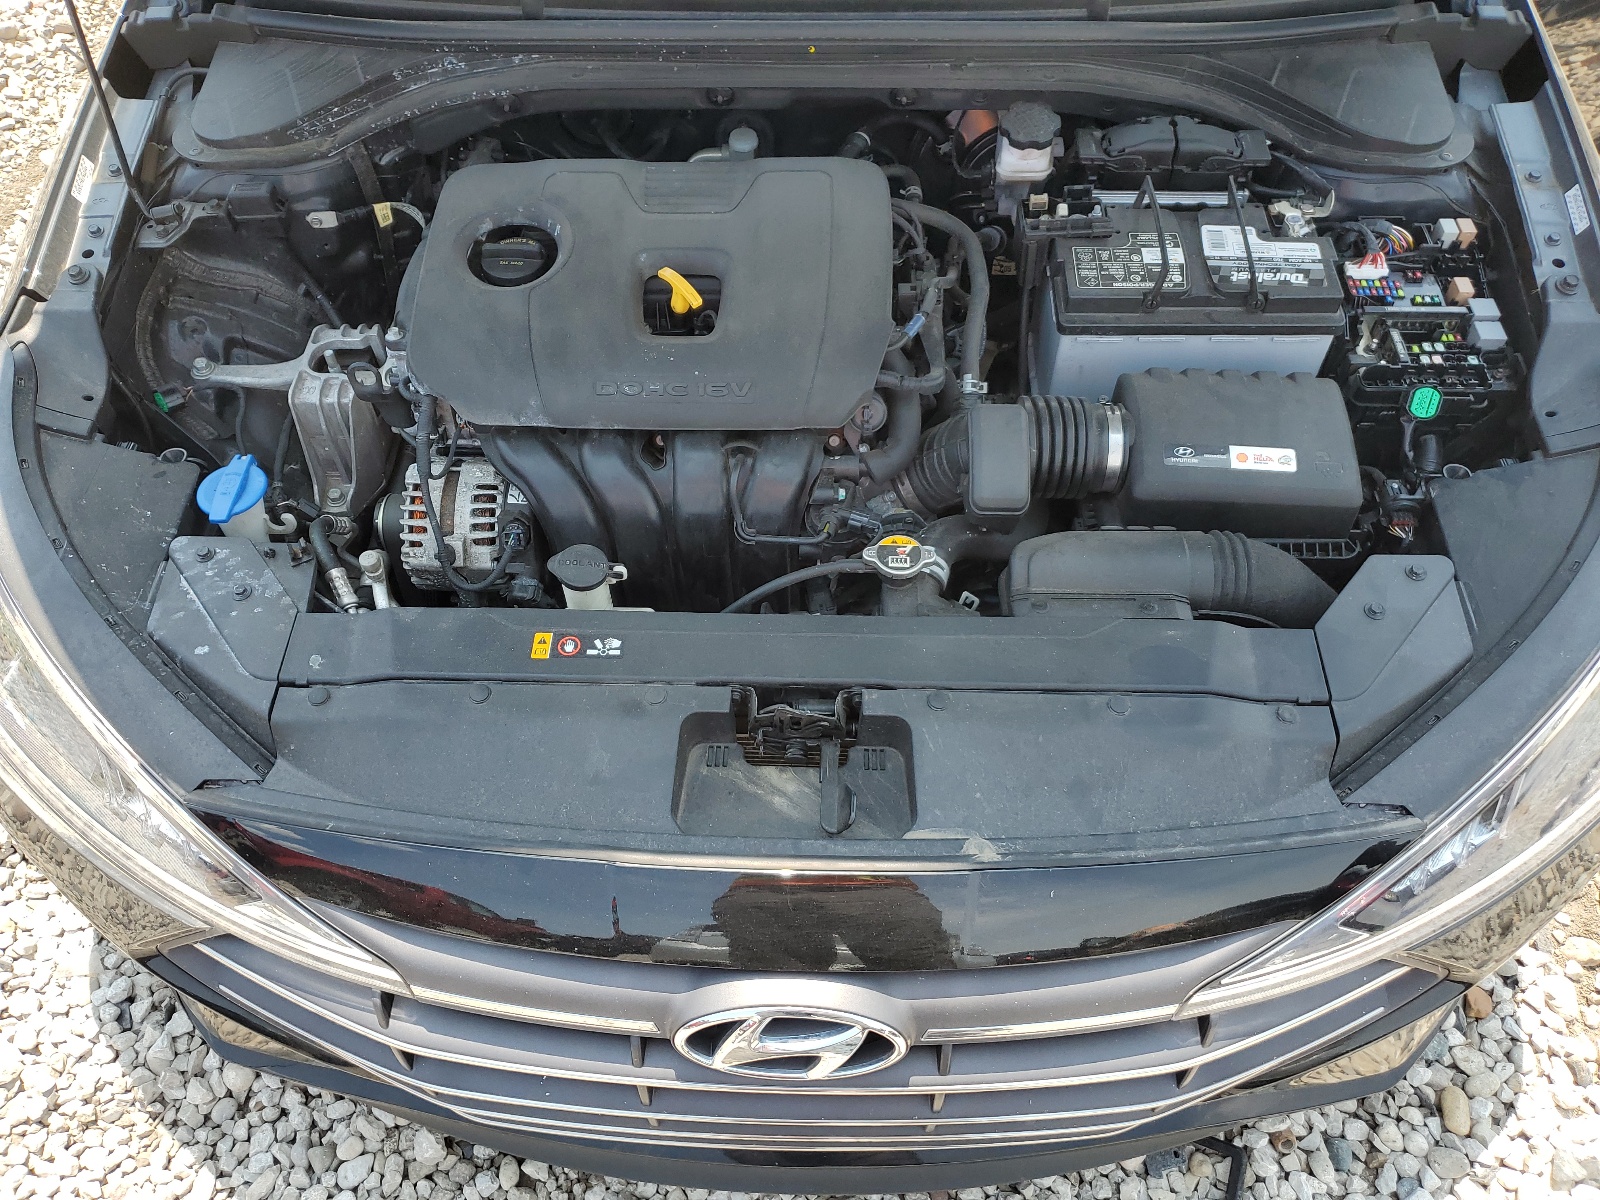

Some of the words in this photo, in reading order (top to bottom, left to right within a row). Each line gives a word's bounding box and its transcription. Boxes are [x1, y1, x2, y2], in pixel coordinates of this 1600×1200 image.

[594, 380, 689, 397] DOHC
[697, 380, 752, 397] 16V
[559, 560, 606, 569] COOLANT
